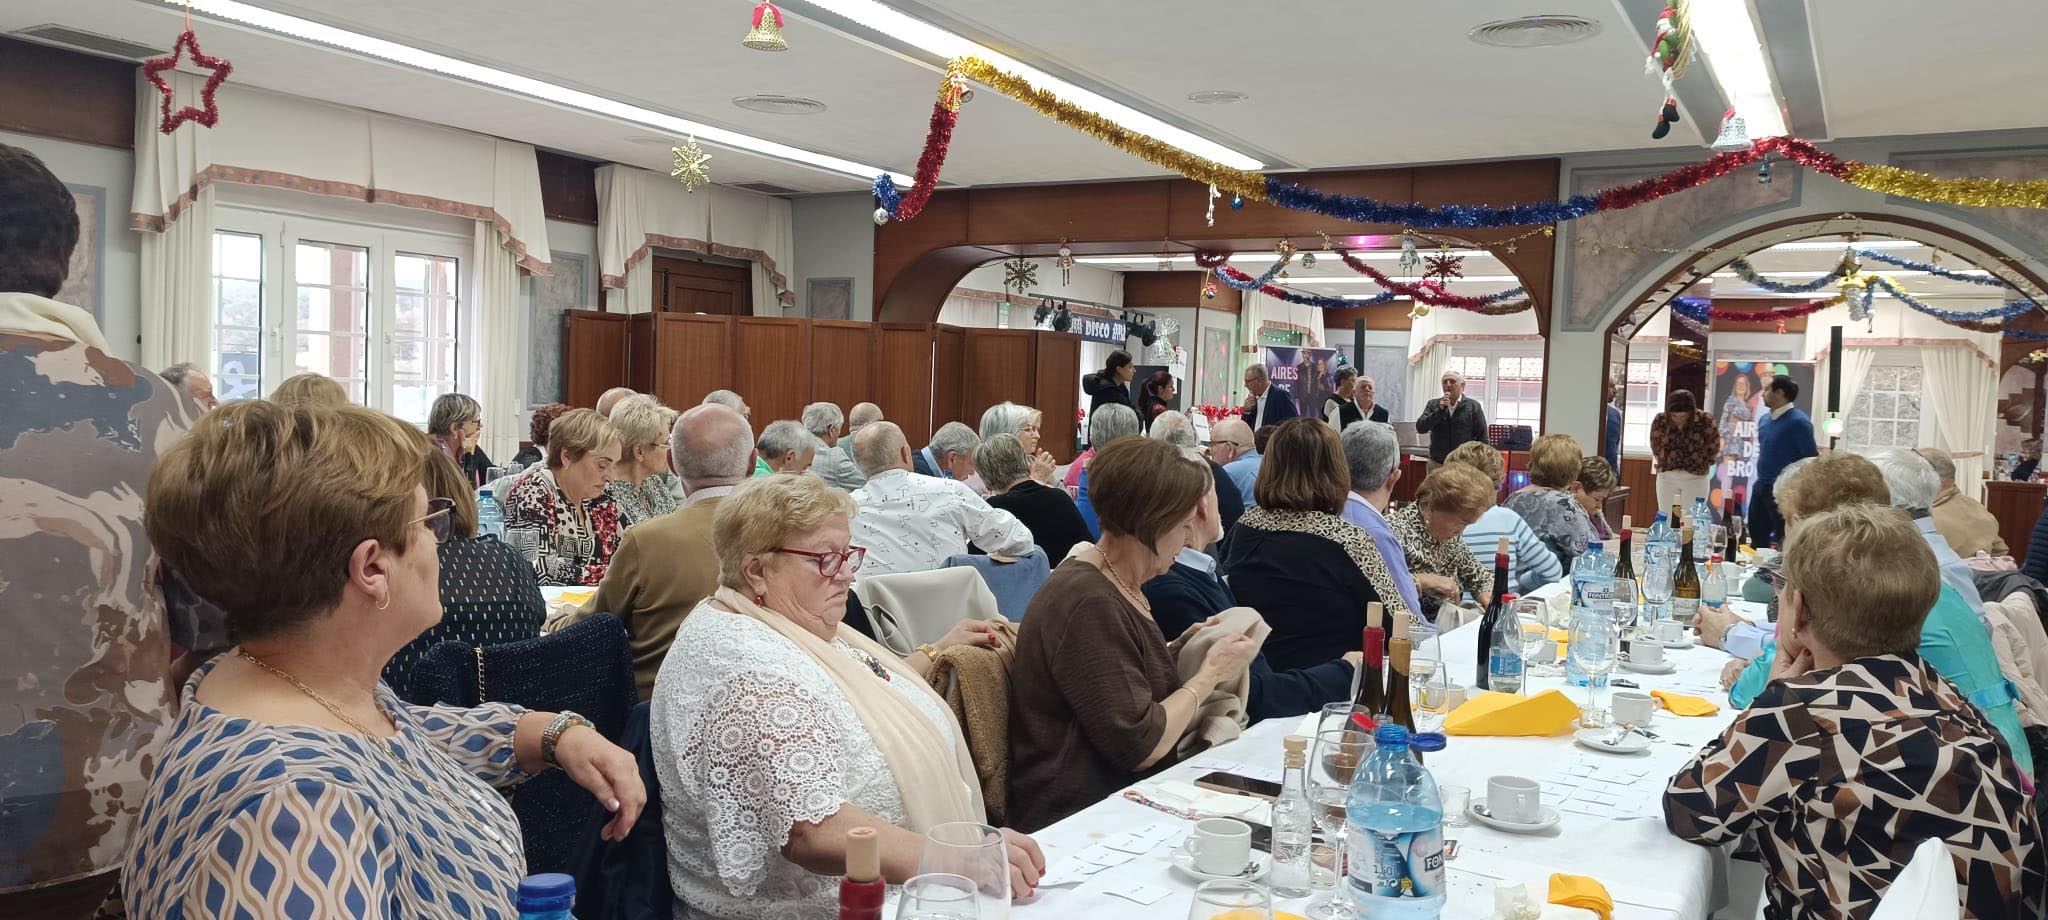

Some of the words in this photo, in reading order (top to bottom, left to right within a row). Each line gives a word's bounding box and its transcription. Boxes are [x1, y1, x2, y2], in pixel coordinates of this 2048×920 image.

[1085, 319, 1110, 339] DISCO
[1271, 366, 1299, 380] AIRES
[1733, 421, 1757, 438] AIR
[1743, 441, 1761, 458] DE
[1727, 460, 1754, 477] BRO
